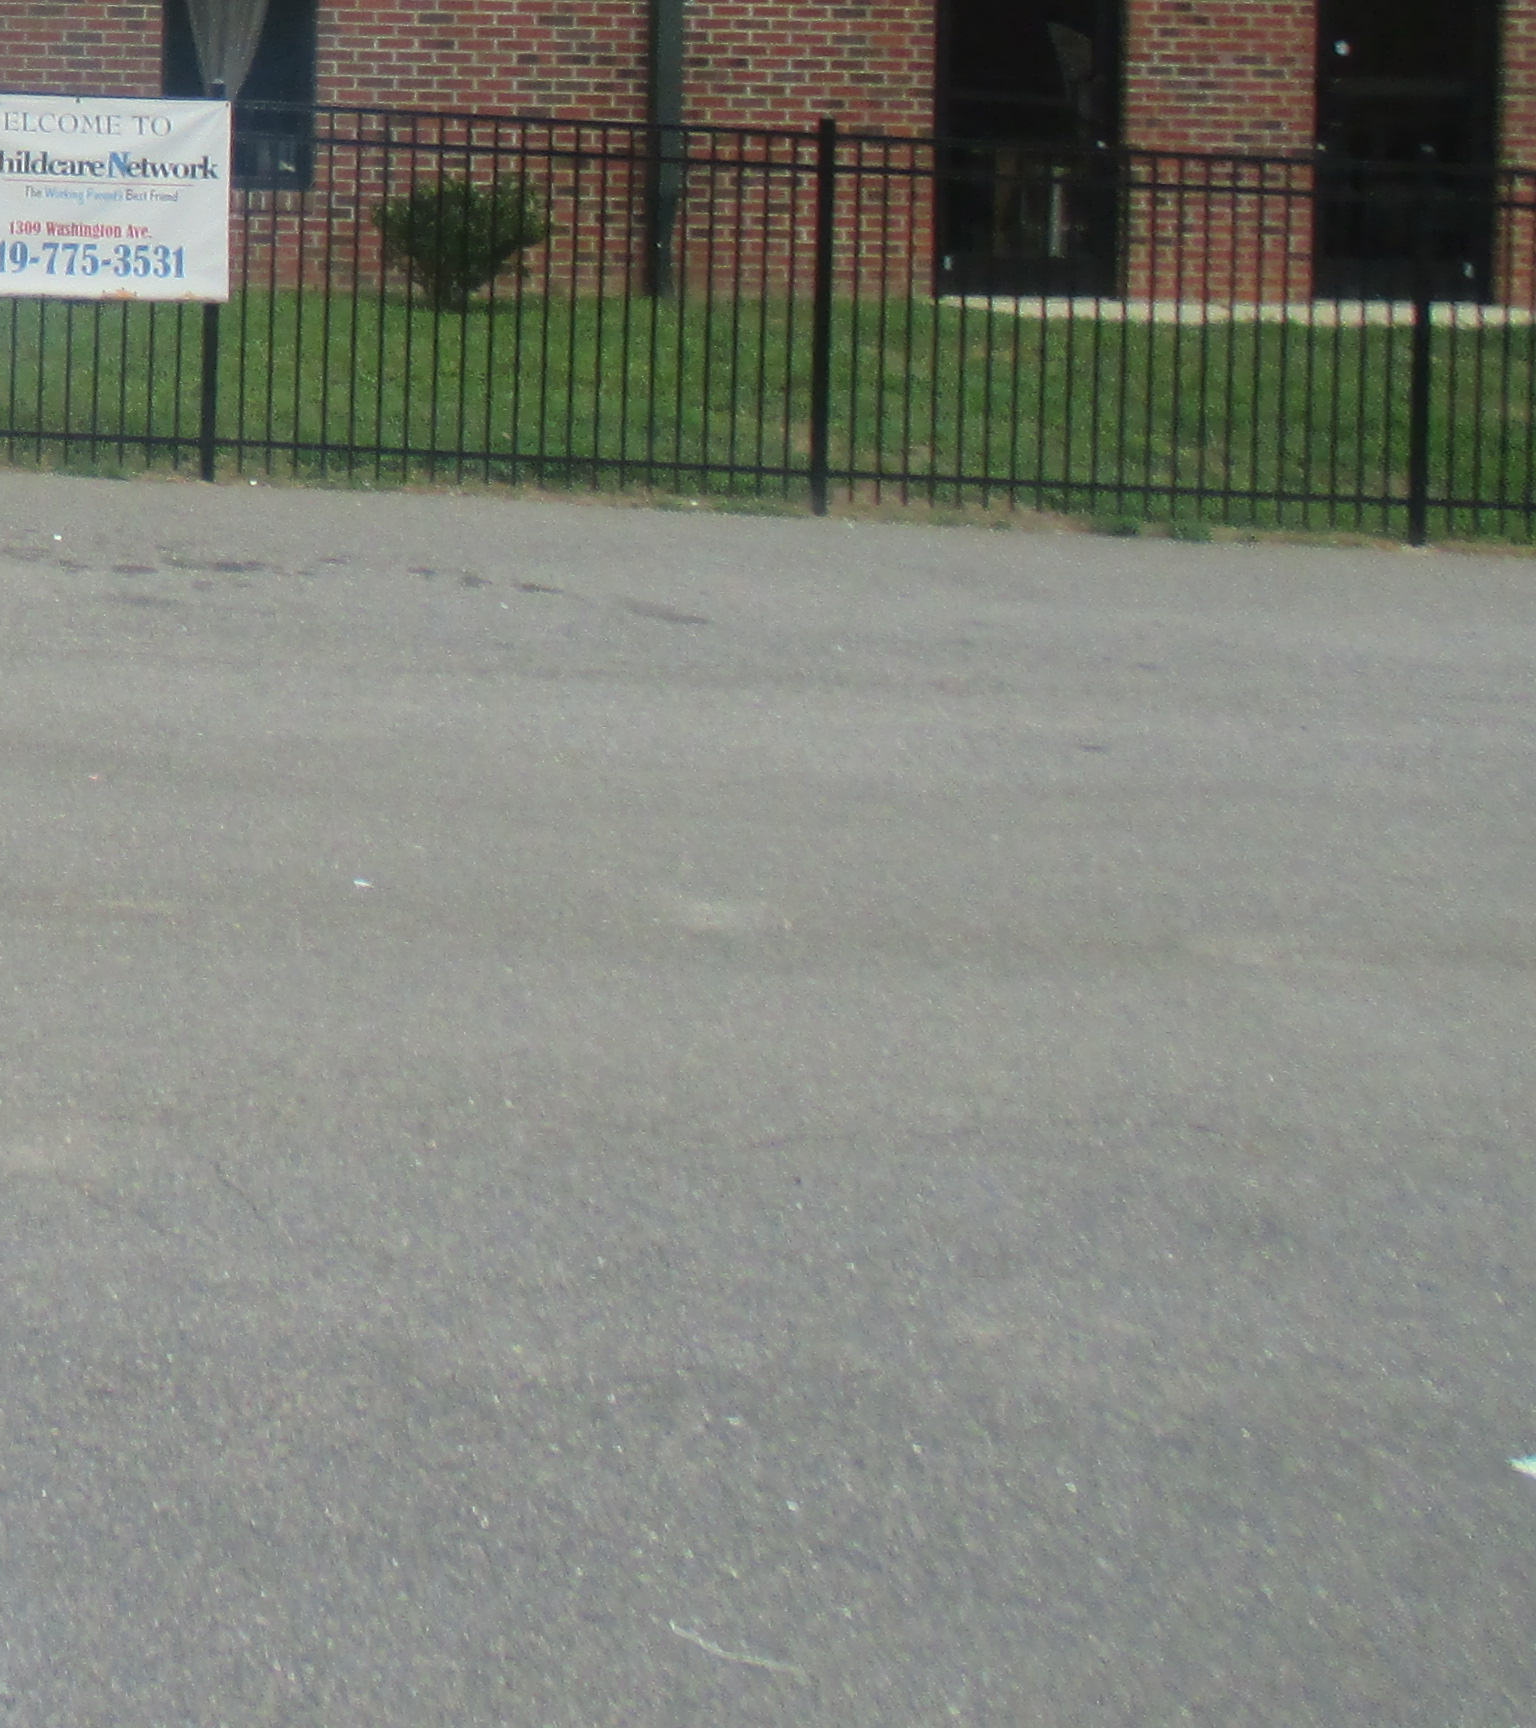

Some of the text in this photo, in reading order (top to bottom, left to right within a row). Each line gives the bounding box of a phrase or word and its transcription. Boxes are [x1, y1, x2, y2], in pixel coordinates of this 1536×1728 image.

[132, 115, 172, 137] TO
[25, 186, 42, 199] The
[126, 189, 148, 201] Best
[46, 221, 122, 239] Washington
[126, 224, 153, 239] Ave.
